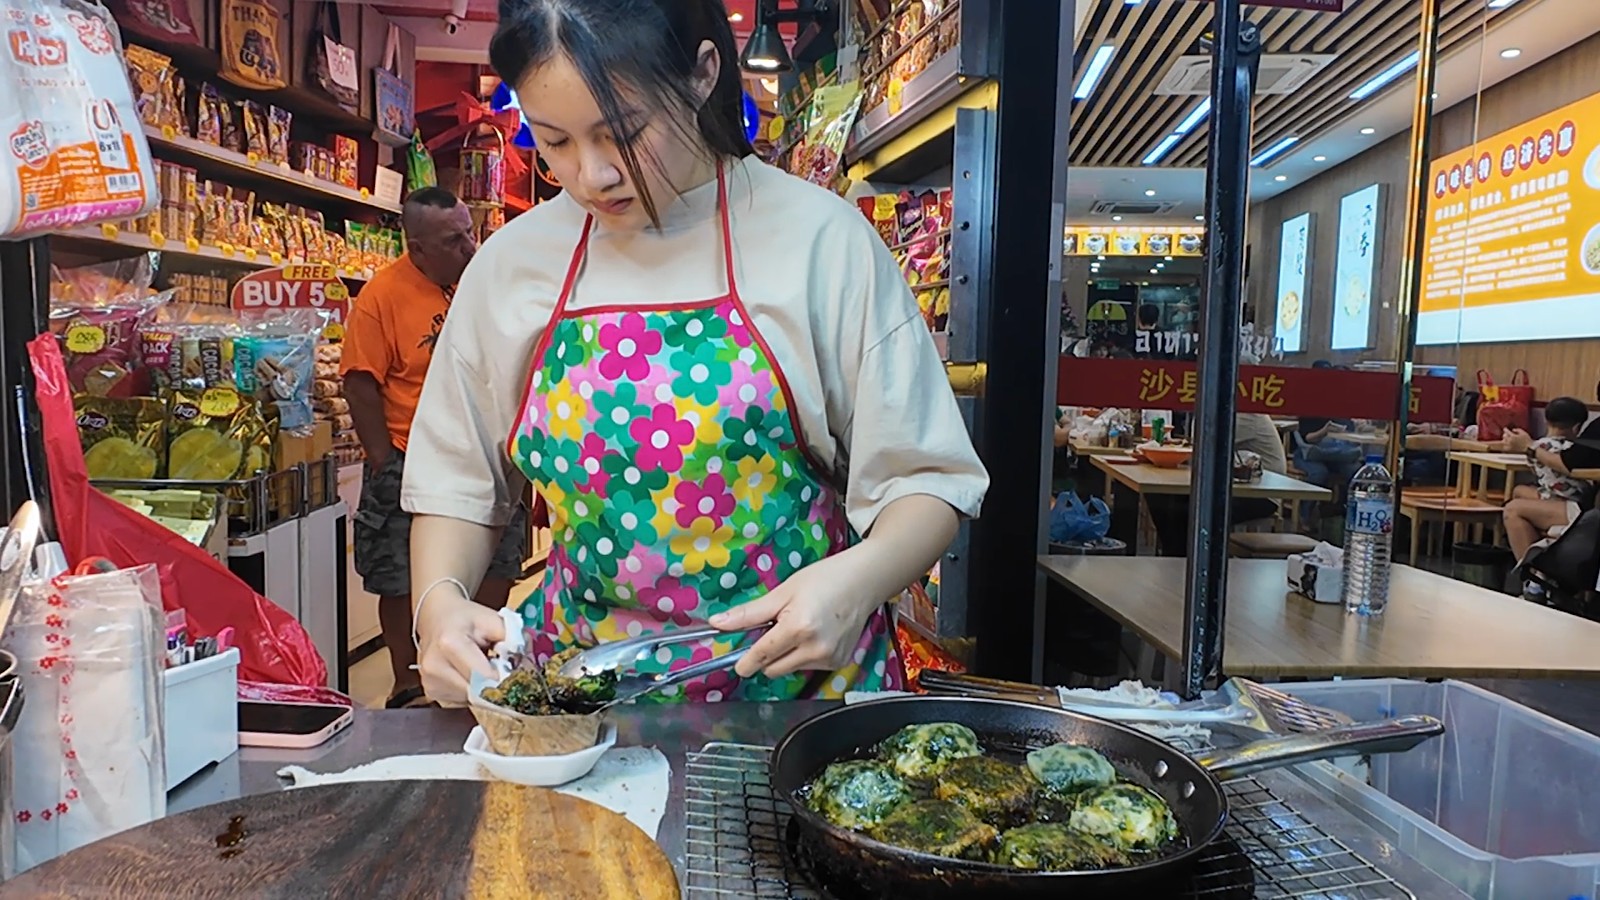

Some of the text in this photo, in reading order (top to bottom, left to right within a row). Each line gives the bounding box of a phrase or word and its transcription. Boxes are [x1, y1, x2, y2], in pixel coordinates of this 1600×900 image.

[292, 265, 331, 279] FREE
[243, 280, 303, 306] BUY
[310, 281, 326, 307] 5
[143, 342, 169, 354] PACK
[1139, 368, 1285, 407] 沙县吃
